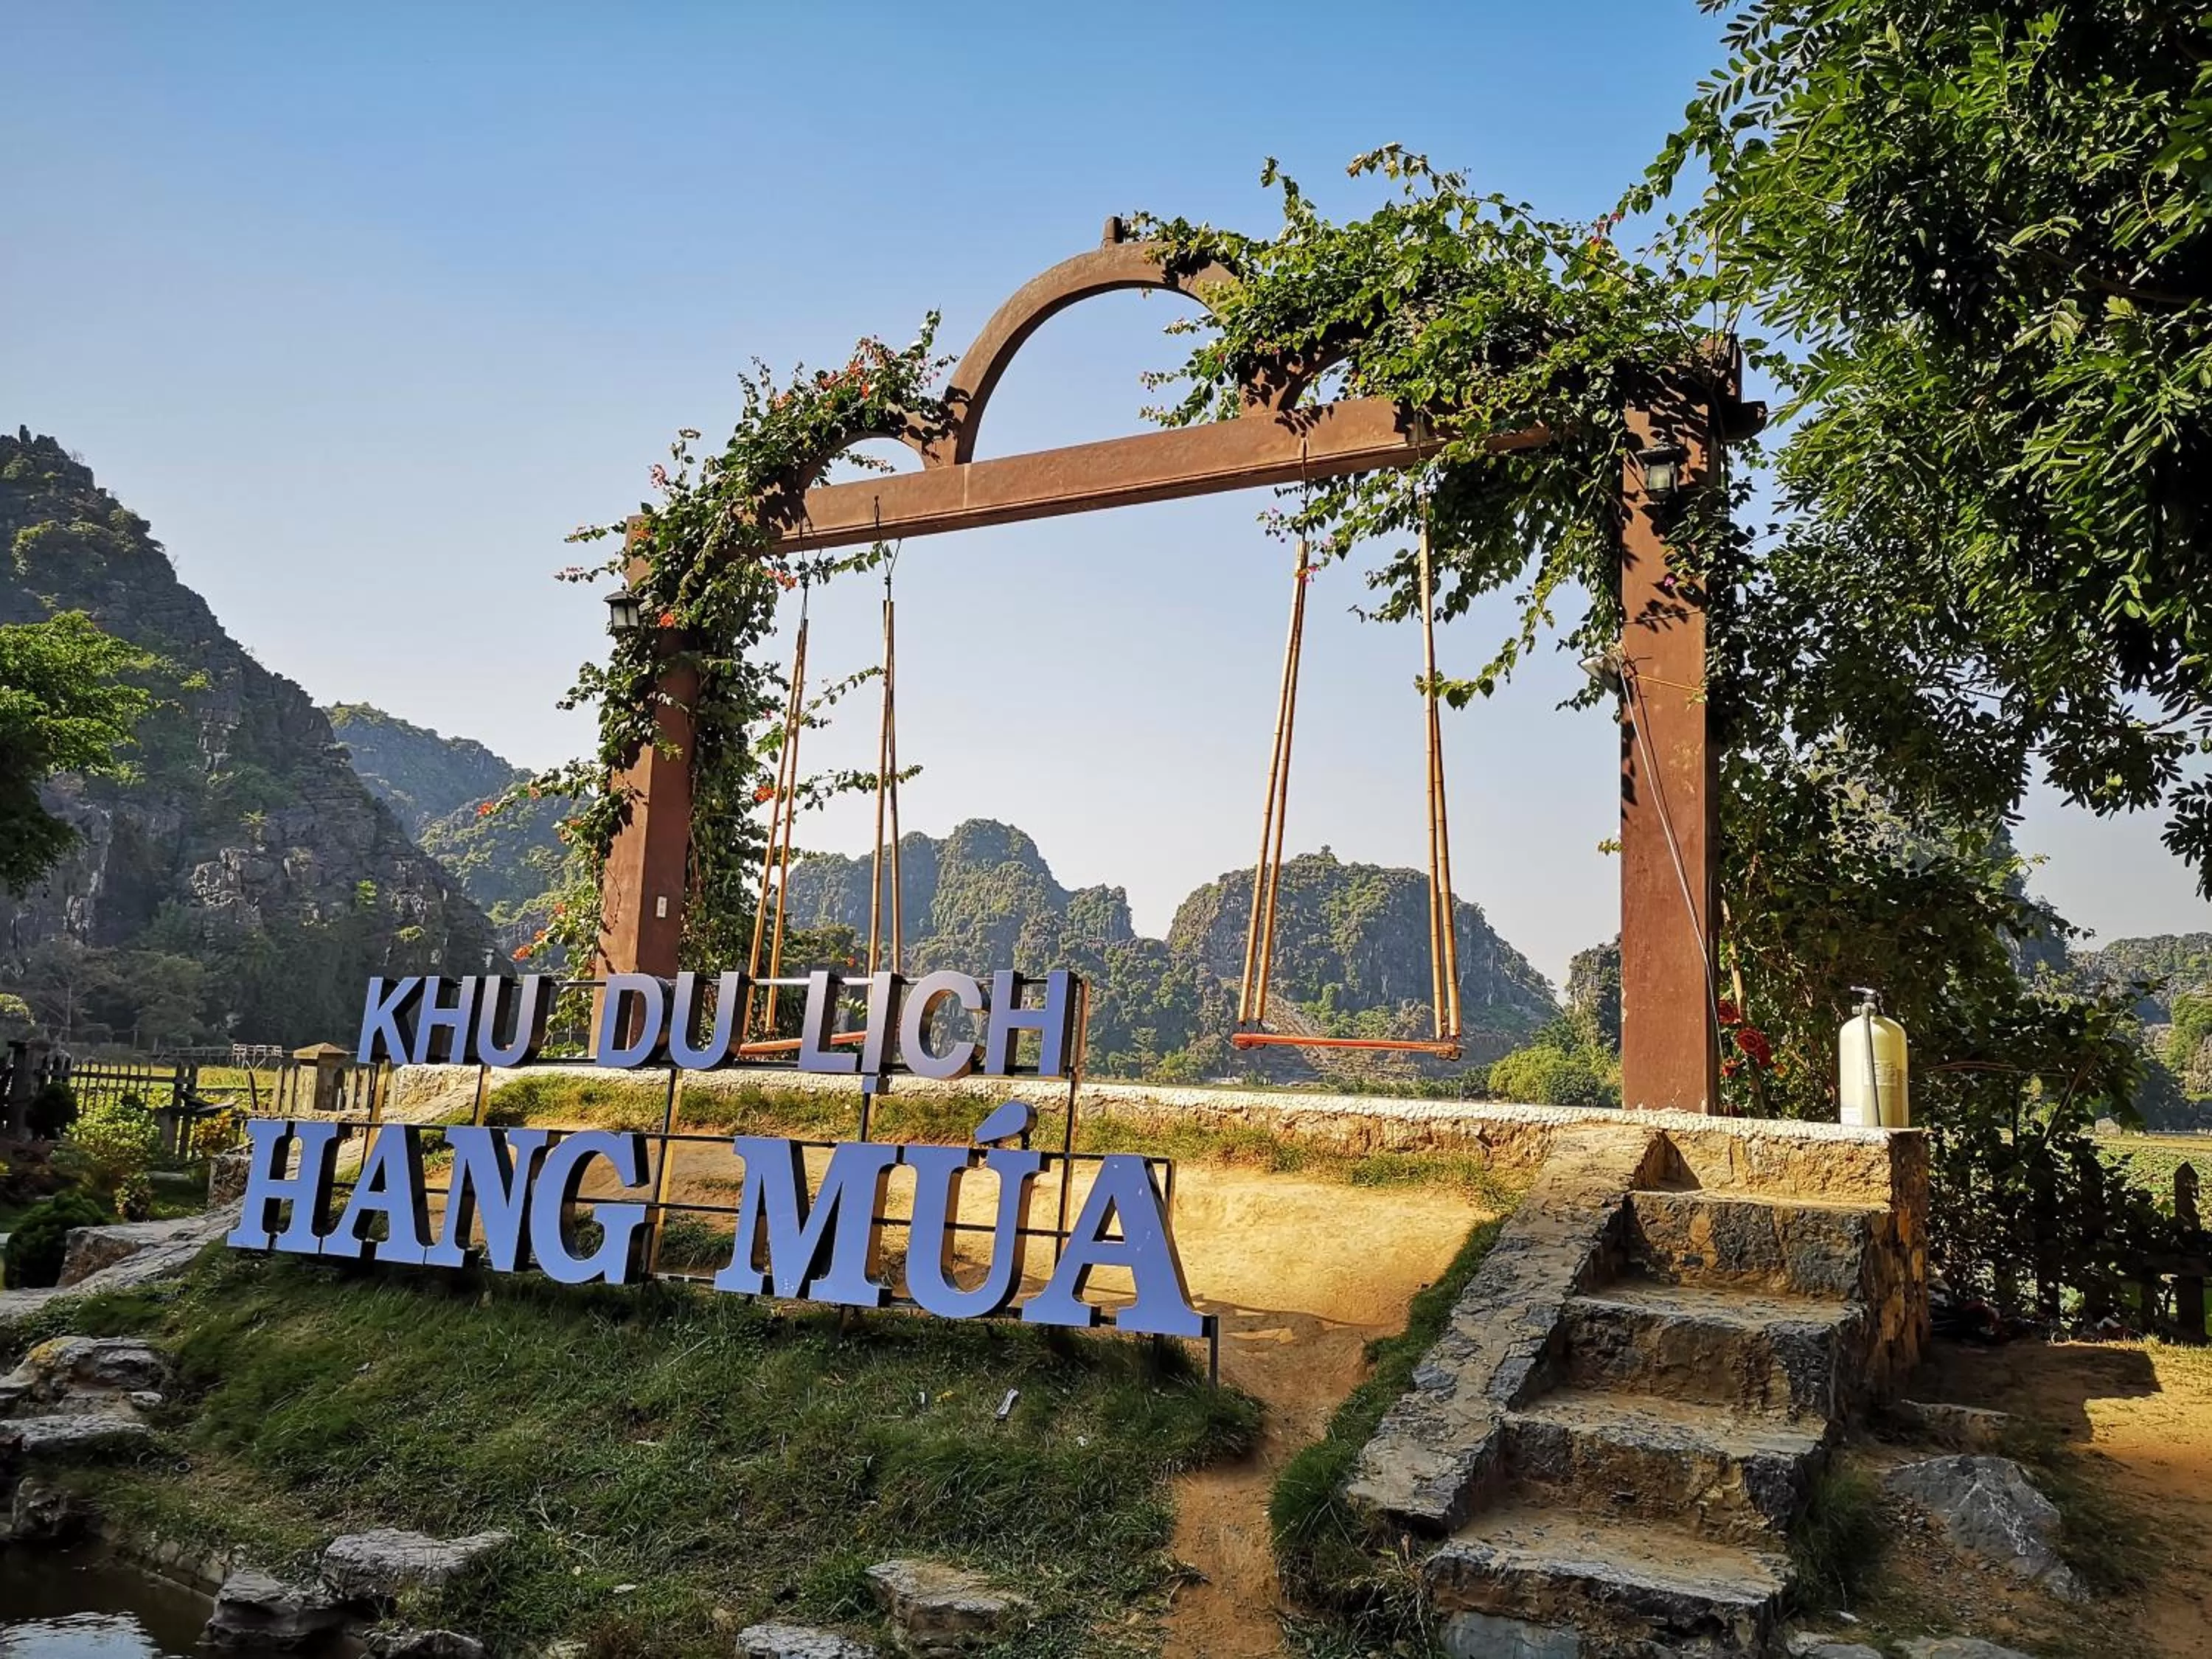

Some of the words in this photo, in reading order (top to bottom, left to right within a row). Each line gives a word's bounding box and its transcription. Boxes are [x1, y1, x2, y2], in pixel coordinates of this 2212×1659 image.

[357, 975, 539, 1066] KHU
[597, 972, 739, 1070] DU
[227, 1119, 647, 1284] HANG
[714, 1099, 1203, 1338] MÚA
